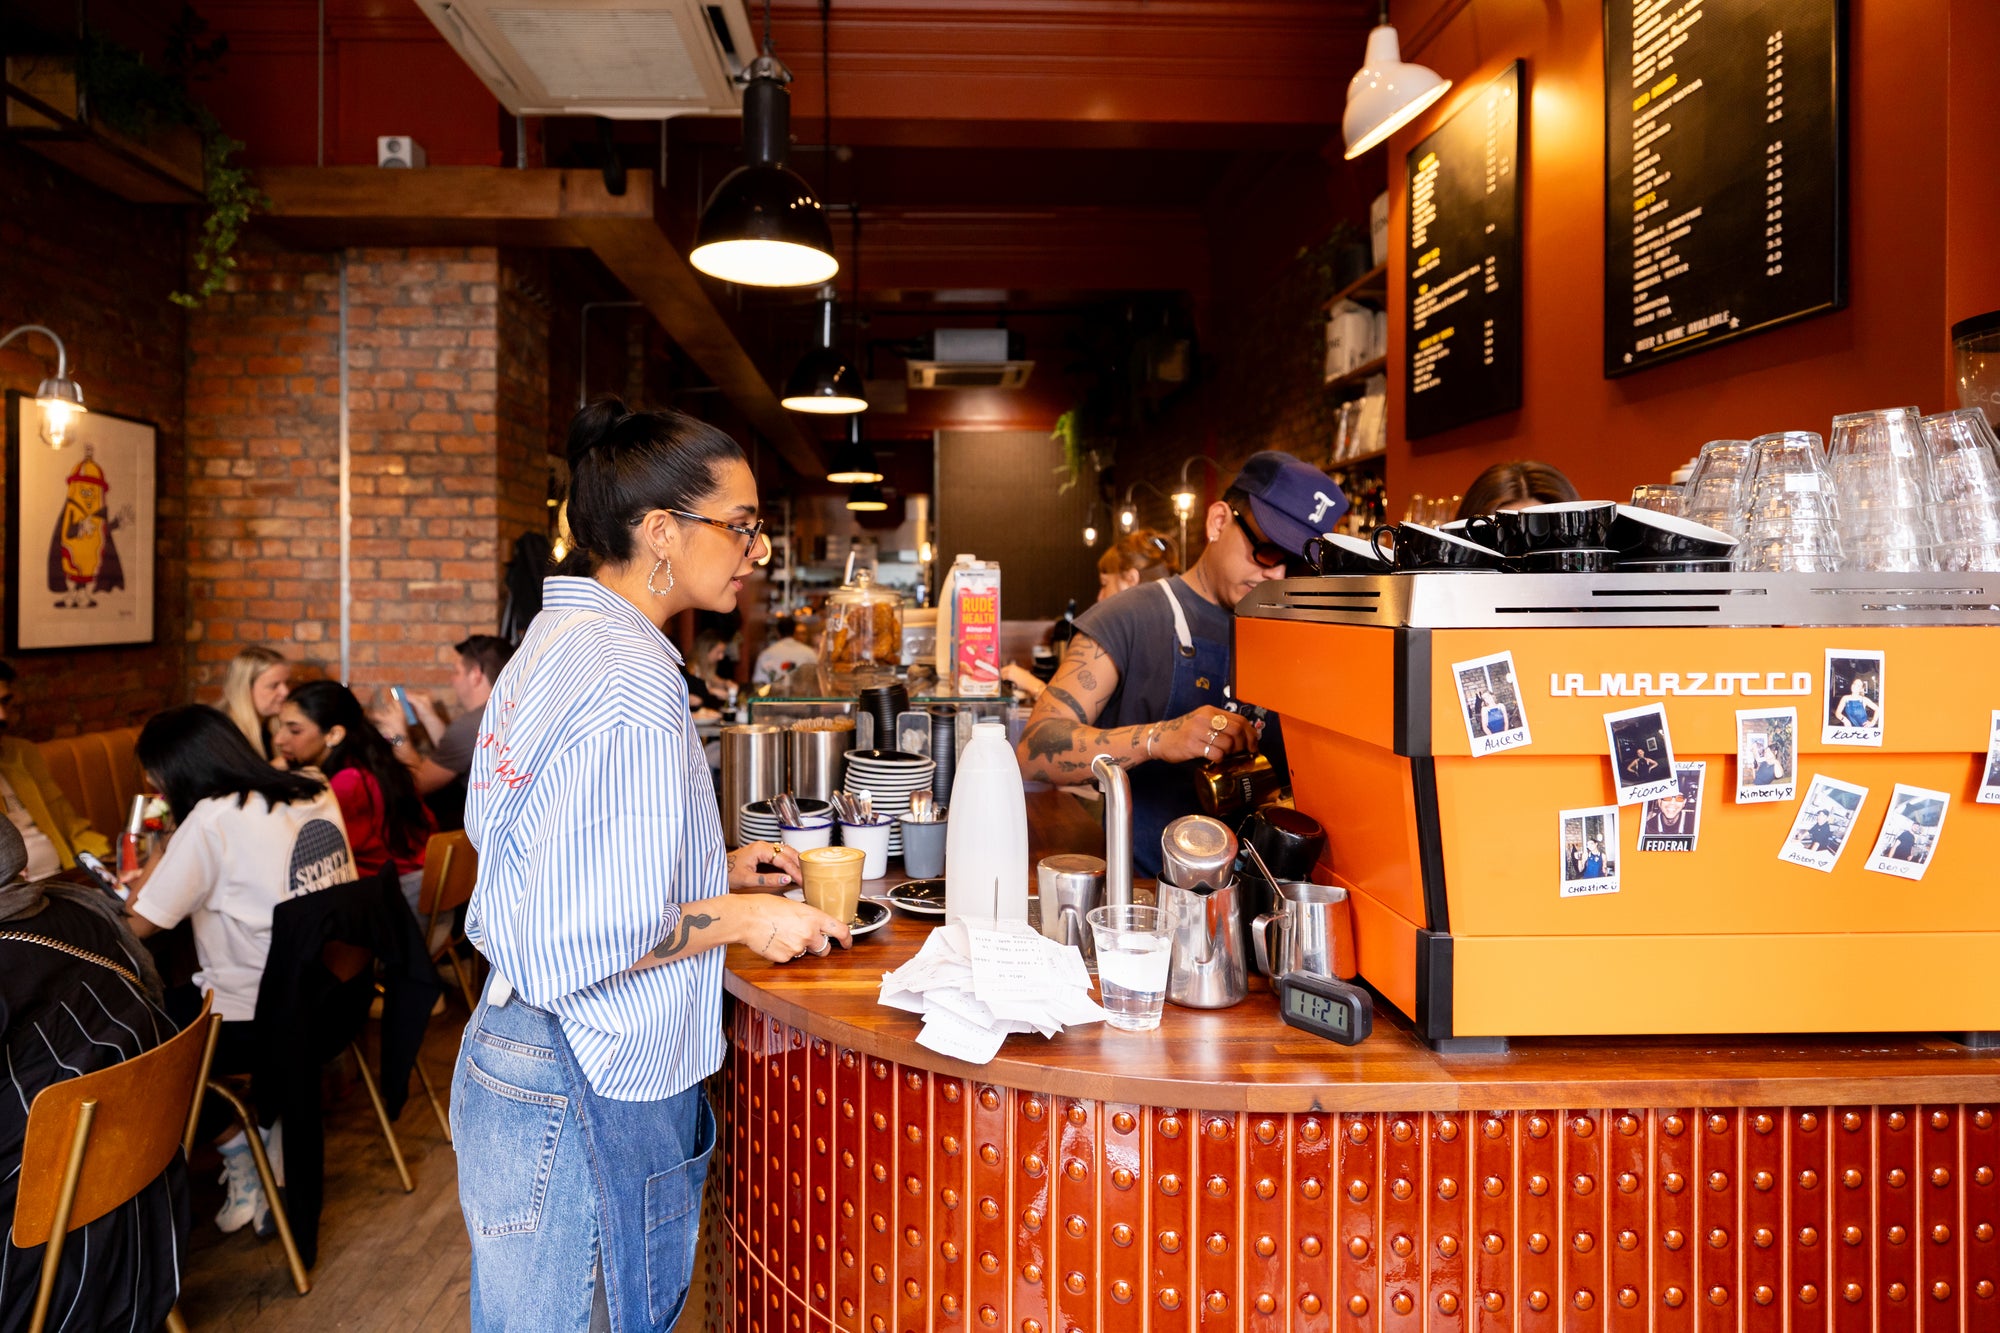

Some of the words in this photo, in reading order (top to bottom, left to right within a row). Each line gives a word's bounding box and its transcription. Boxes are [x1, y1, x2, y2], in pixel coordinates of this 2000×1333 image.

[1686, 310, 1730, 335] AVAILABLE
[962, 597, 995, 613] RUDE
[962, 613, 995, 625] HEALTH
[1550, 673, 1584, 697] LA
[1645, 840, 1690, 852] FEDERAL
[1300, 992, 1344, 1027] 11:21
